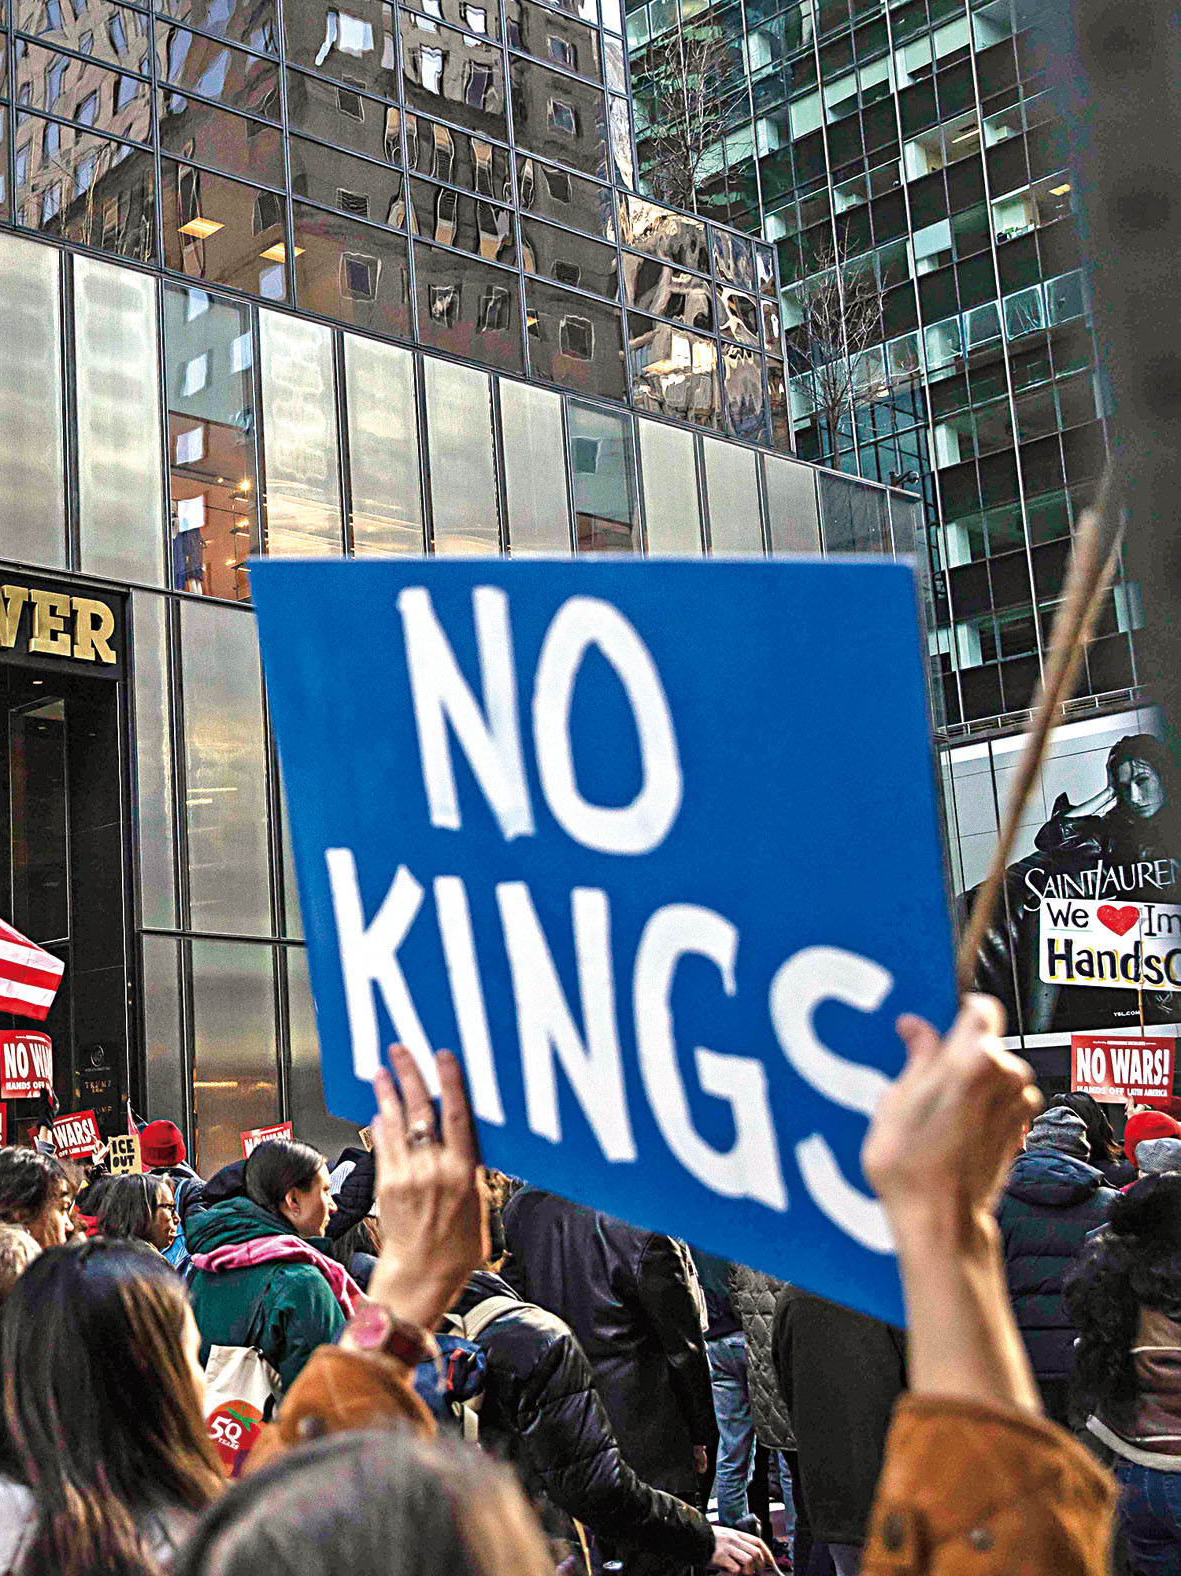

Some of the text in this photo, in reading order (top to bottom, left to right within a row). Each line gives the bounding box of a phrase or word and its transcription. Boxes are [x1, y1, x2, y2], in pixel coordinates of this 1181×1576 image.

[397, 585, 683, 856] NO
[1023, 867, 1099, 911] SAINT
[1047, 902, 1089, 929] We
[3, 1042, 29, 1079] NO
[325, 847, 895, 1254] KINGS
[1076, 1047, 1170, 1086] NO WARS!
[6, 1081, 31, 1090] HANDS
[1076, 1085, 1168, 1097] HANDS OFF LATIN AMERICA
[52, 1118, 96, 1149] WARS!
[112, 1138, 135, 1155] ICE
[112, 1155, 135, 1168] OUT
[218, 1437, 240, 1450] YEARS
